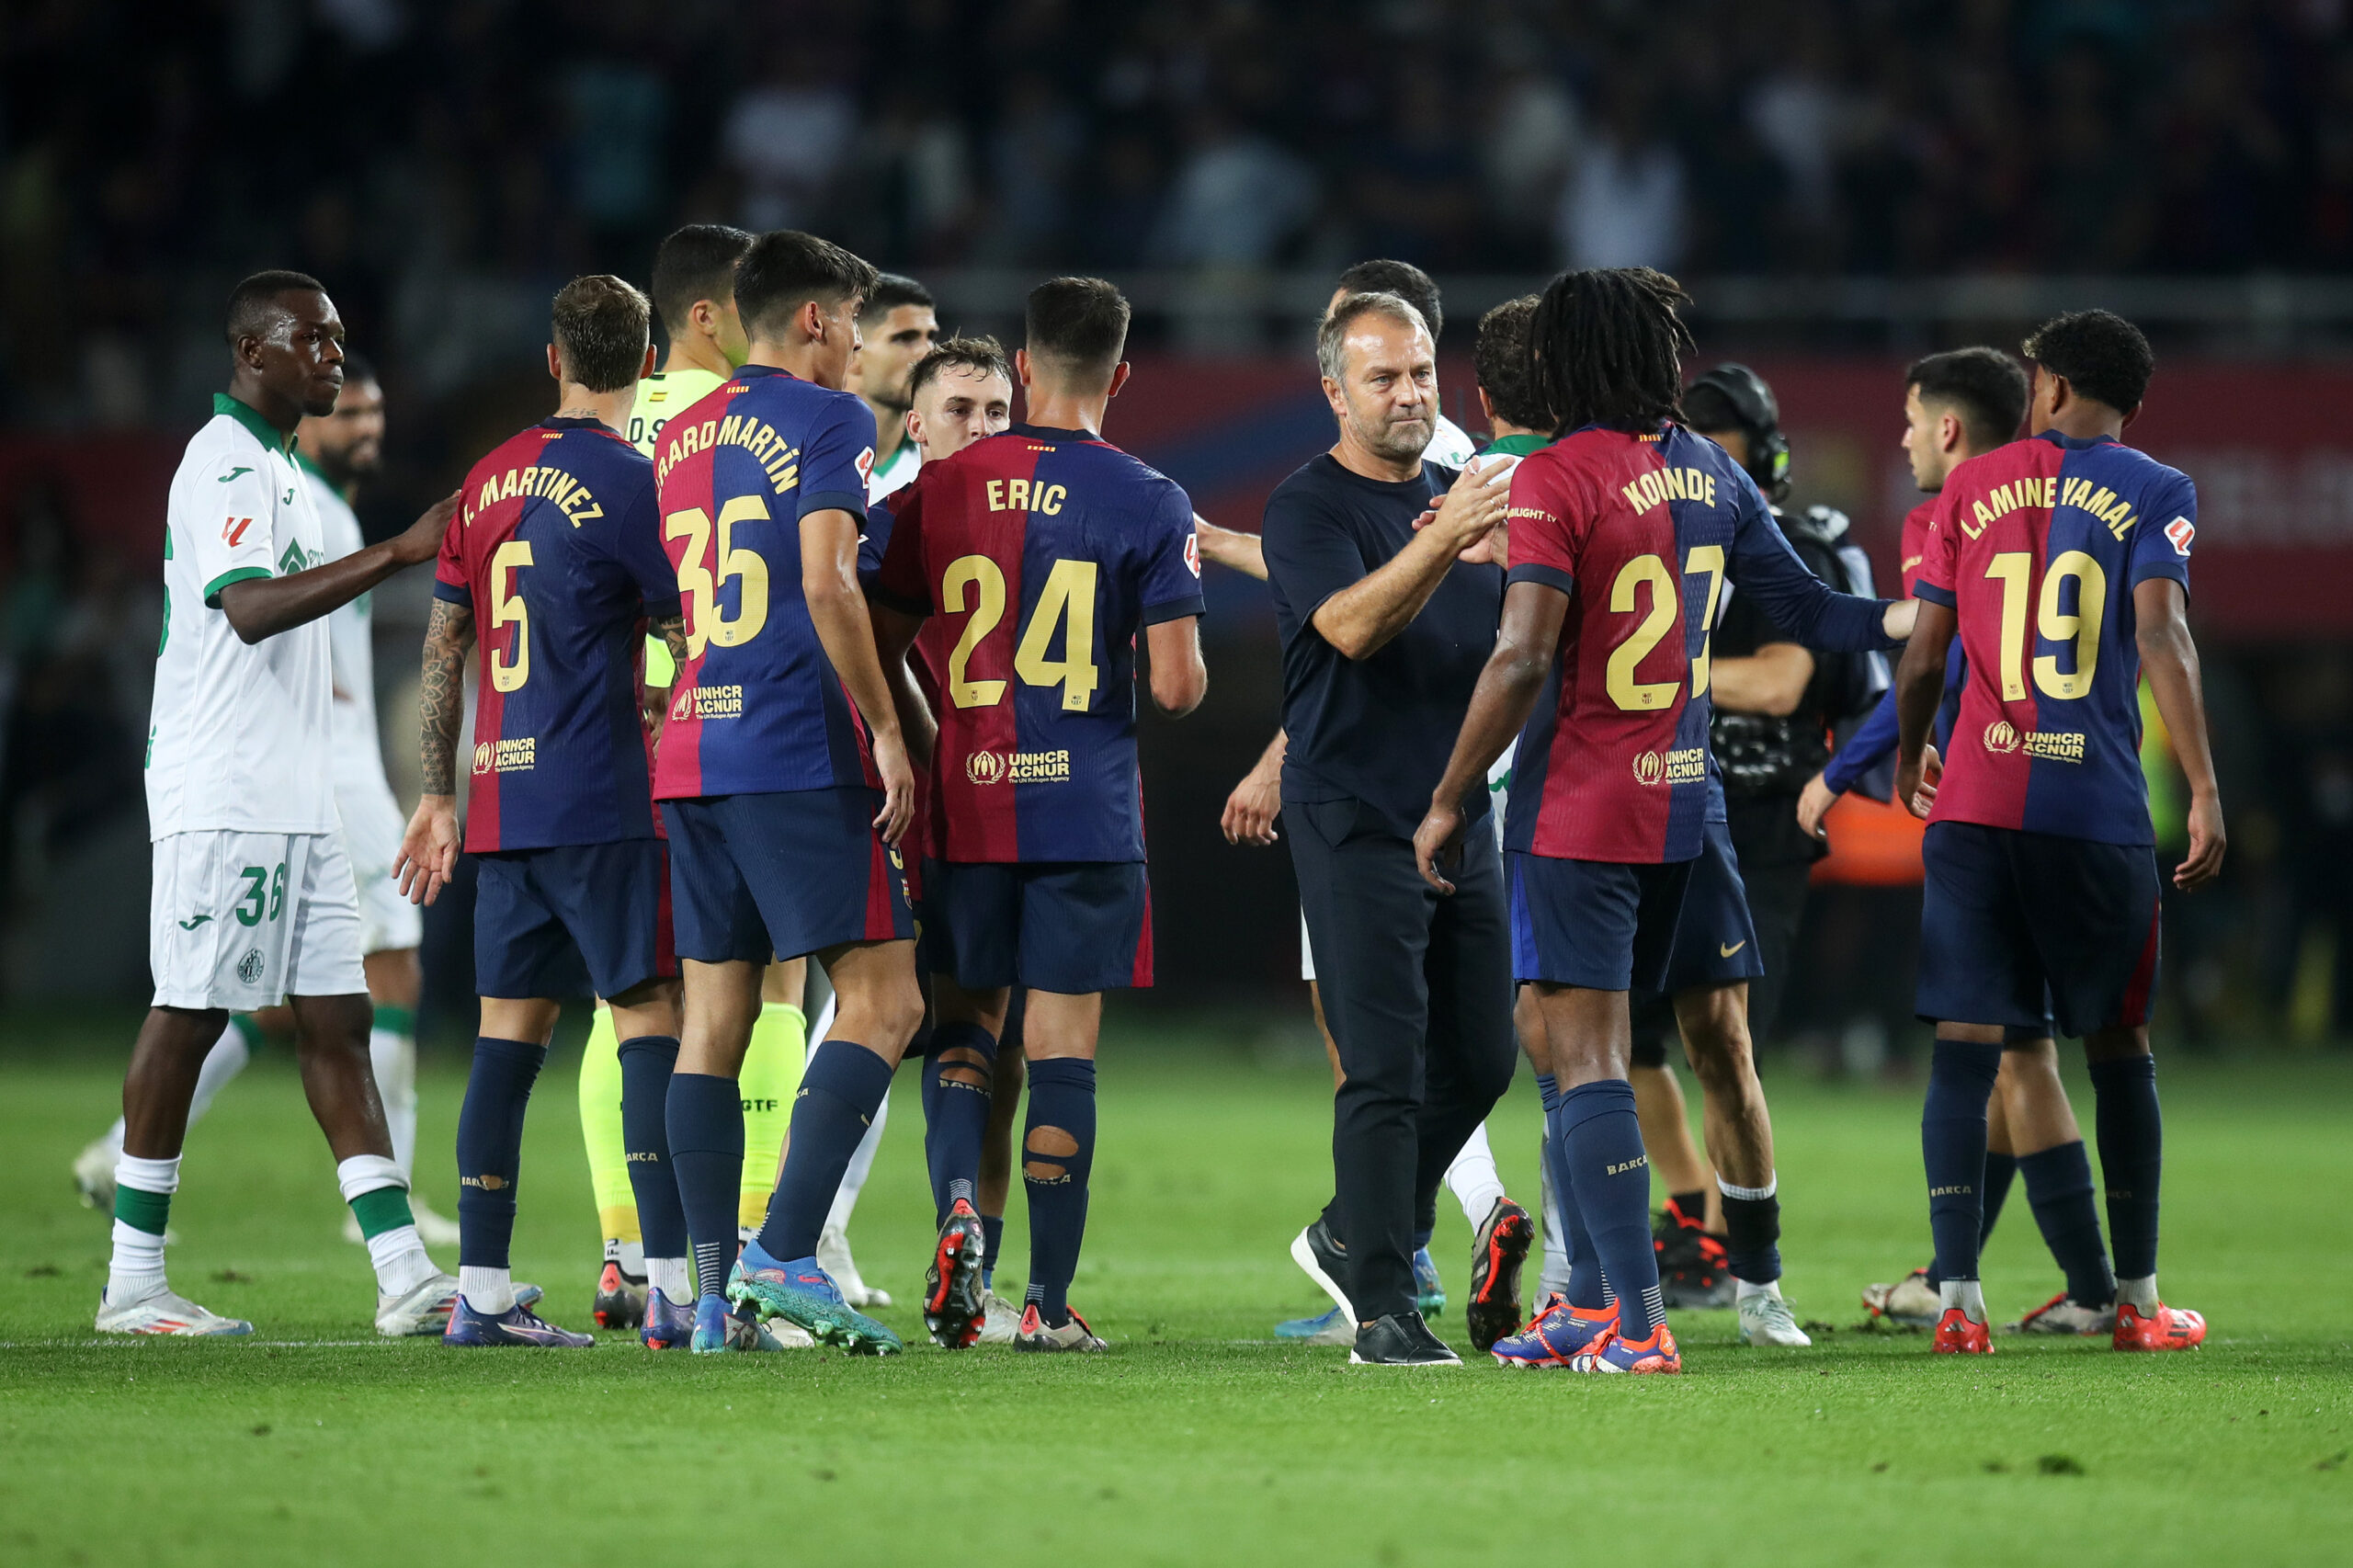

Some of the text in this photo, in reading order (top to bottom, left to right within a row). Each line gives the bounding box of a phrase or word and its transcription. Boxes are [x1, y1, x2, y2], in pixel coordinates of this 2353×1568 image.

[655, 415, 800, 503] RARD MARTÍN
[479, 467, 605, 528] MARTINEZ
[986, 479, 1067, 516] ERIC
[1622, 467, 1716, 517] KOUNDE
[1961, 477, 2057, 540] LAMINE
[2061, 477, 2139, 542] YAMAL
[665, 494, 771, 661] 35
[491, 540, 534, 693] 5
[1984, 550, 2107, 702] 19
[942, 554, 1098, 712] 24
[693, 685, 743, 700] UNHCR
[695, 699, 743, 713] ACNUR
[495, 737, 536, 754] UNHCR
[2025, 732, 2085, 745] UNHCR
[494, 750, 535, 767] ACNUR
[1008, 750, 1069, 766] UNHCR
[1665, 748, 1704, 765] UNHCR
[2022, 742, 2084, 758] ACNUR
[1007, 763, 1070, 778] ACNUR
[1665, 762, 1705, 778] ACNUR
[236, 862, 285, 926] 36
[1607, 1154, 1648, 1176] BARÇA
